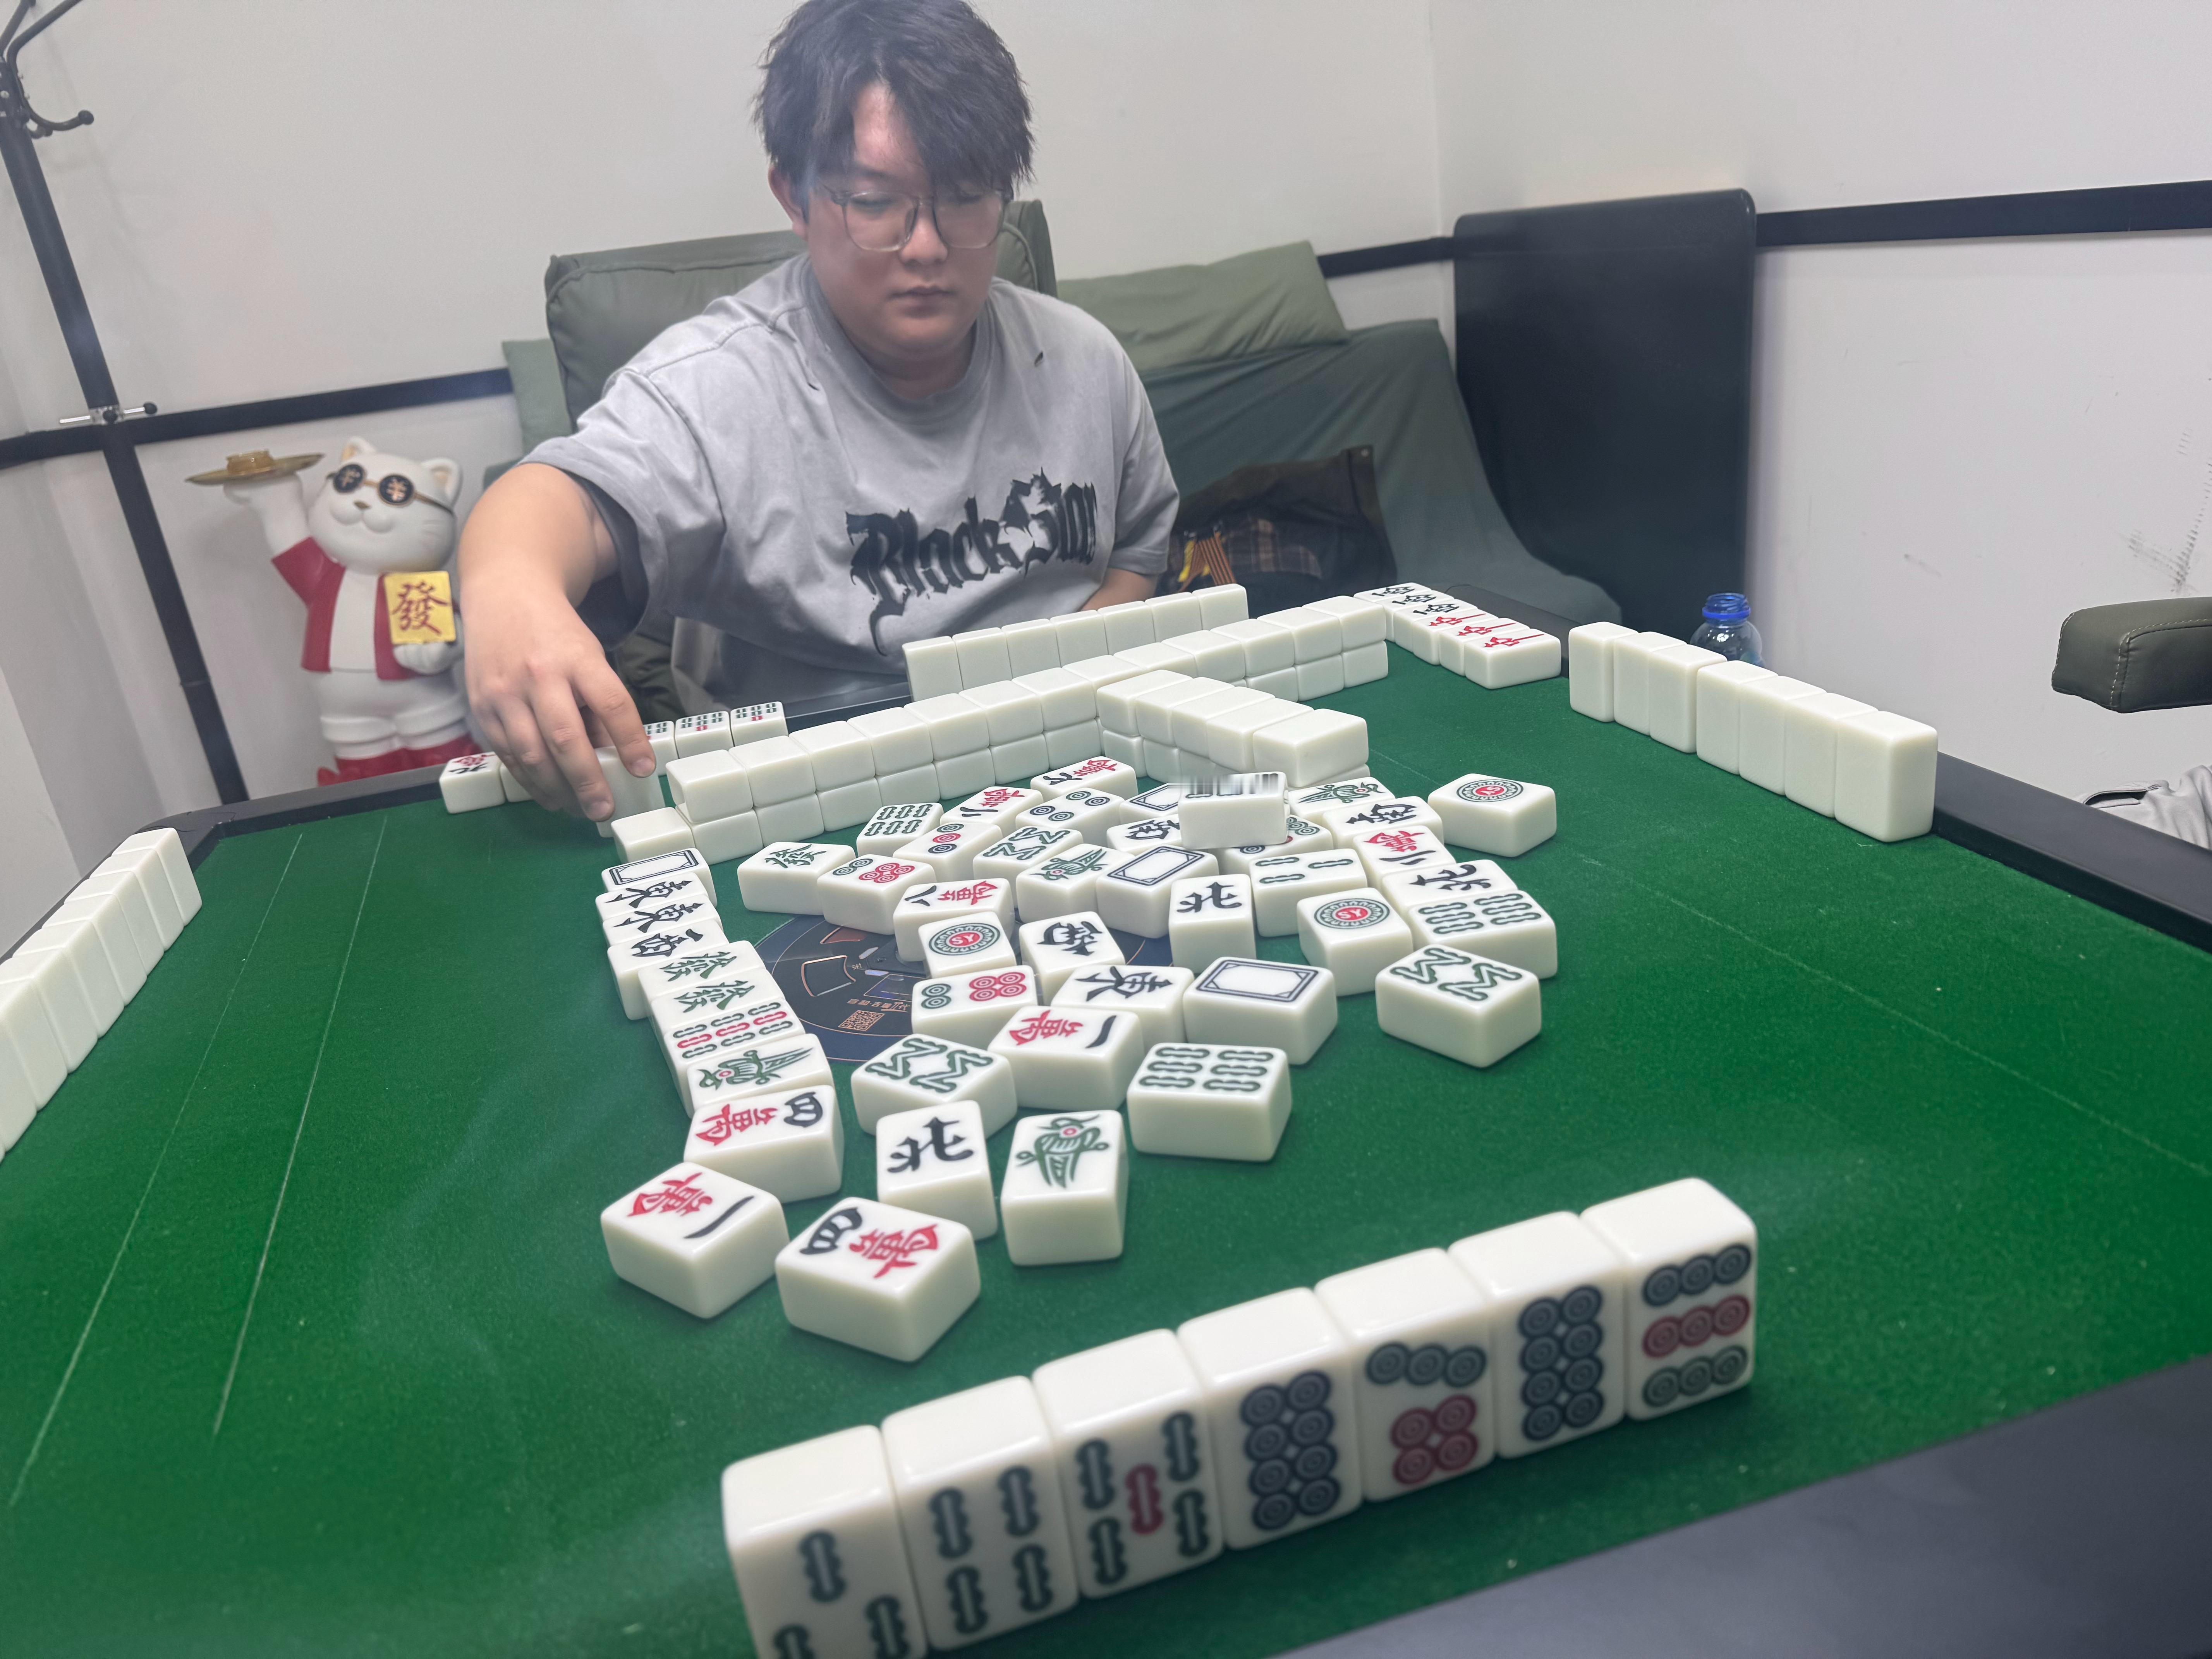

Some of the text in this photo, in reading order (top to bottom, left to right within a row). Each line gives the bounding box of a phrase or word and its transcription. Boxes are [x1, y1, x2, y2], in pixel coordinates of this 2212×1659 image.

[392, 582, 448, 635] 發
[1429, 613, 1486, 626] 中
[1456, 623, 1516, 635] 中
[1483, 634, 1544, 647] 中
[1480, 786, 1501, 795] SY
[1346, 804, 1417, 824] 南
[764, 844, 826, 868] 發
[1409, 864, 1491, 891] 北
[605, 881, 692, 908] 東
[1176, 882, 1242, 912] 北
[613, 903, 704, 933] 東
[1338, 908, 1362, 919] SY
[952, 934, 975, 945] SY
[1037, 921, 1103, 956] 南
[659, 951, 737, 982] 發
[673, 980, 755, 1012] 發
[1075, 966, 1173, 1002] 東
[887, 1117, 974, 1173] 北
